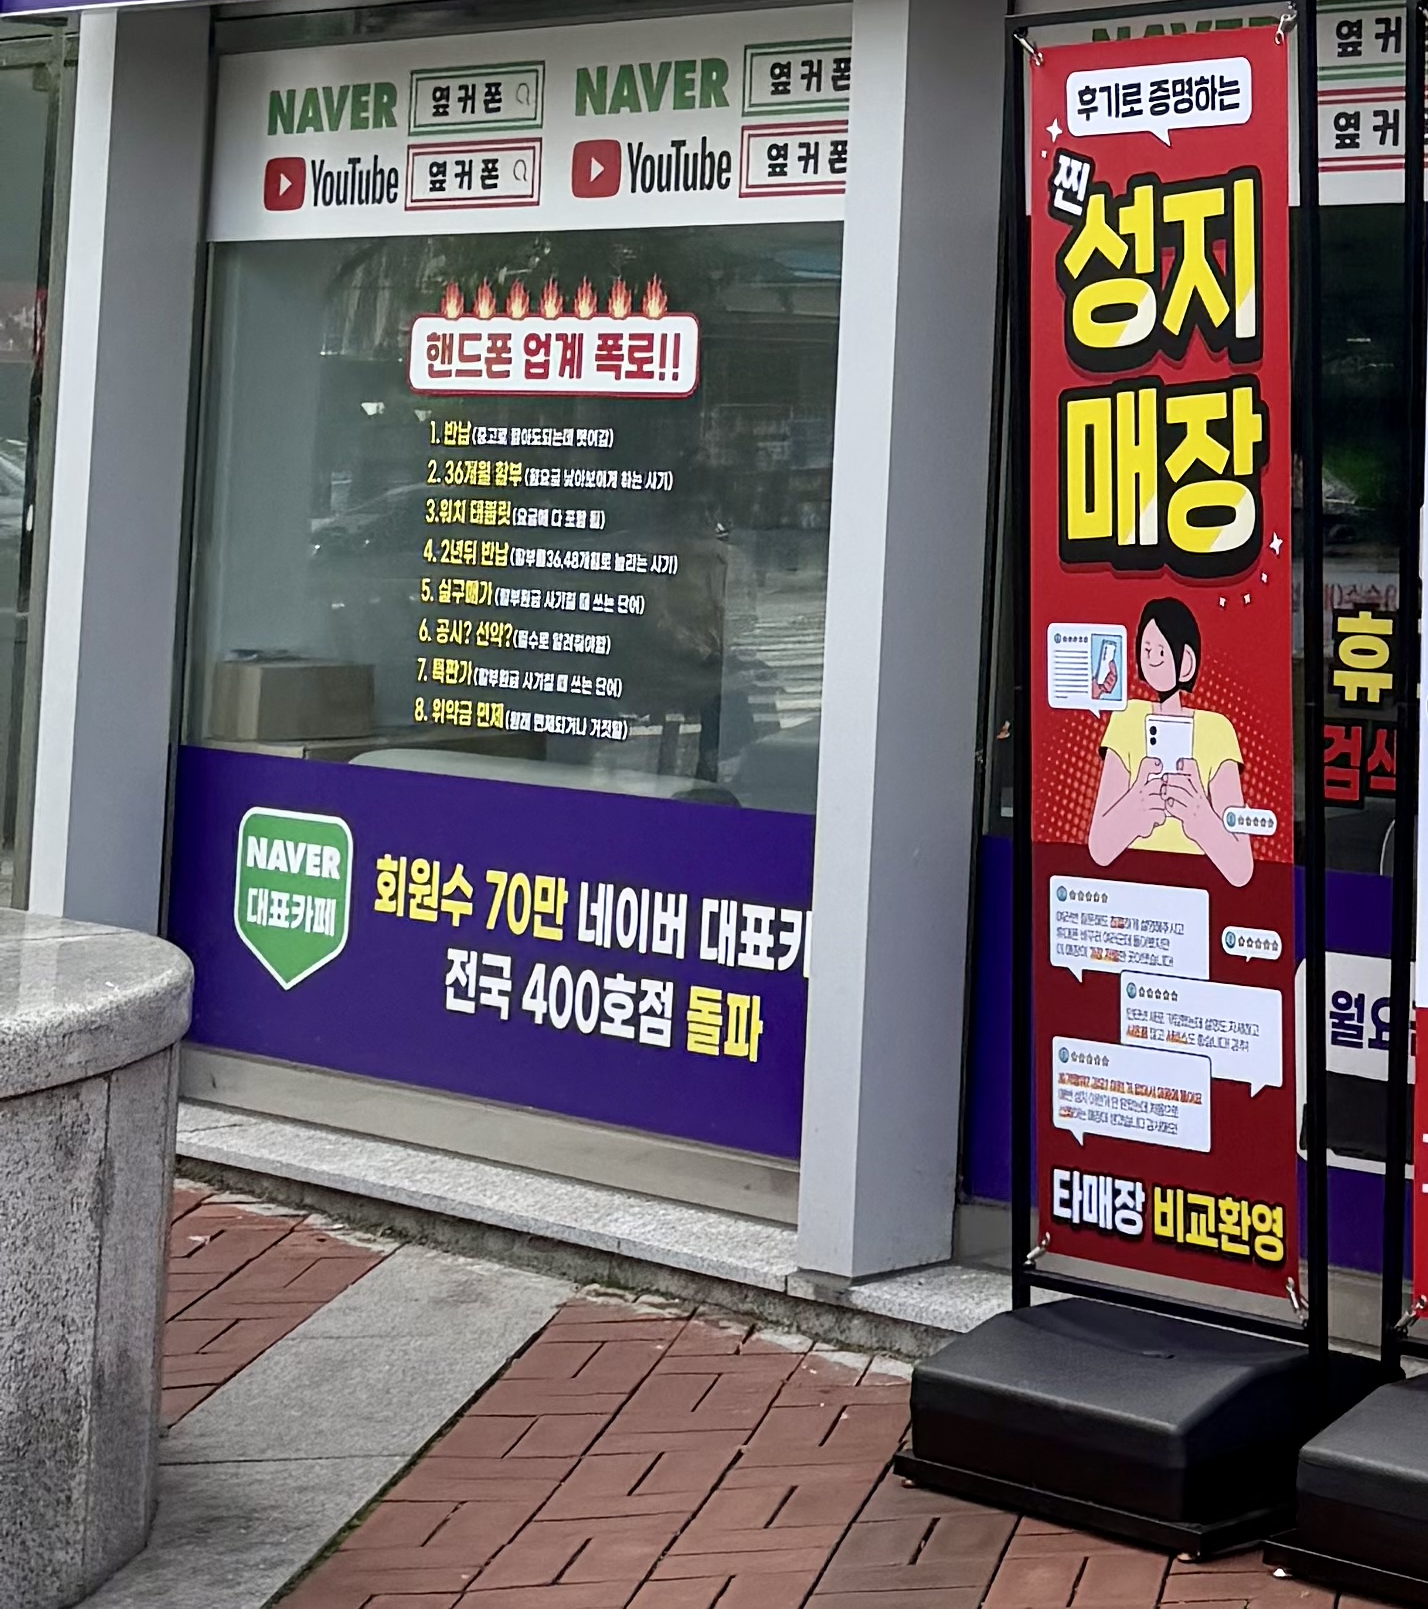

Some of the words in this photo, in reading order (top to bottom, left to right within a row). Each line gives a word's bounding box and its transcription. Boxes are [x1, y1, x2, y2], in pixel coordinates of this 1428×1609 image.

[266, 82, 397, 136] NAVER
[574, 58, 730, 117] NAVER
[1077, 82, 1143, 121] 후기로
[1149, 74, 1240, 117] 증명하는
[311, 154, 398, 207] YouTube
[626, 136, 732, 195] YouTube
[1053, 153, 1088, 216] 찐
[1064, 178, 1257, 349] 성지
[426, 331, 513, 380] 핸드폰
[523, 332, 583, 380] 업계
[594, 331, 681, 381] 폭로!!
[1067, 387, 1263, 554] 매장
[247, 836, 341, 879] NAVER
[247, 887, 336, 937] 대표카페
[374, 854, 474, 926] 회원수
[485, 867, 567, 941] 70만
[578, 882, 686, 960] 네이버
[445, 947, 512, 1021] 전국
[522, 962, 674, 1048] 400호점
[686, 986, 764, 1063] 돌파
[1052, 1168, 1145, 1236] 타매장
[1153, 1186, 1285, 1262] 비교환영
